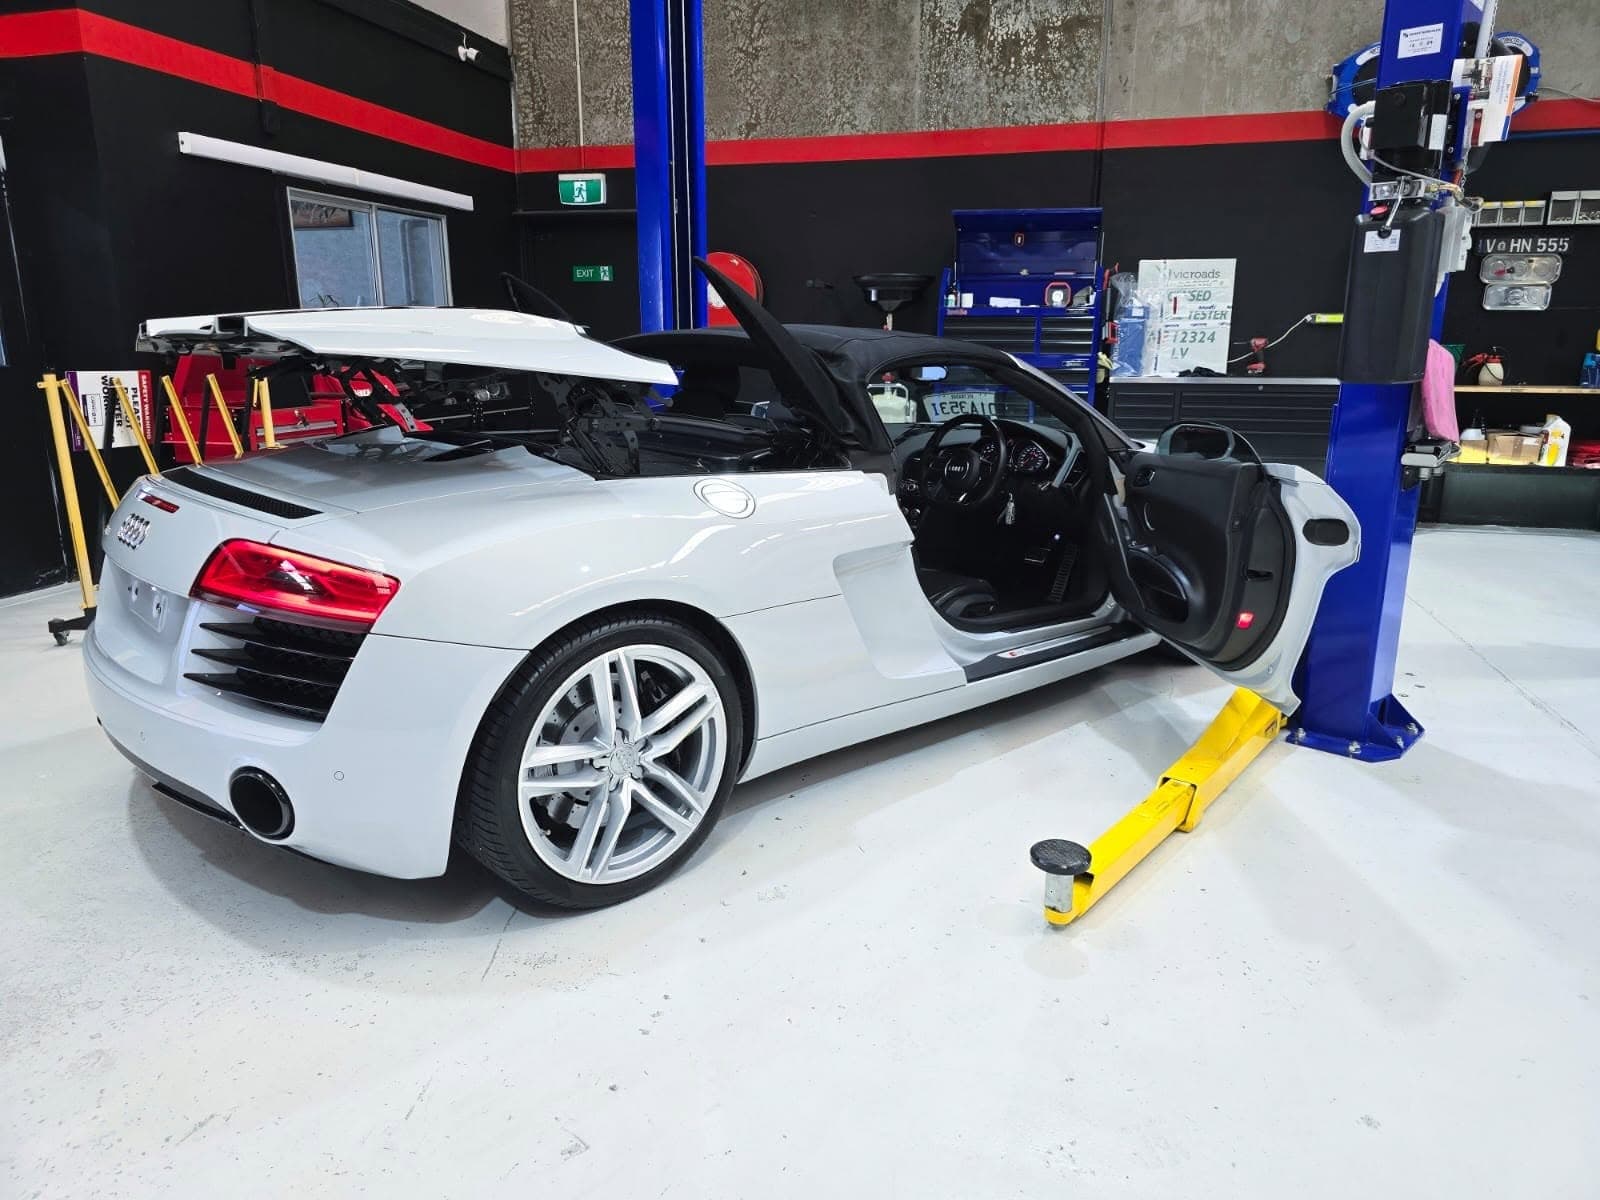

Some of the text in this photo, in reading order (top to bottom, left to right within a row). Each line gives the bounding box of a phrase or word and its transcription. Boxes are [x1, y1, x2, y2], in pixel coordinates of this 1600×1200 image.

[1509, 238, 1532, 253] HN
[1537, 238, 1570, 252] 555
[576, 269, 595, 278] EXIT
[1173, 268, 1221, 279] vicroads
[1188, 310, 1229, 320] TESTER
